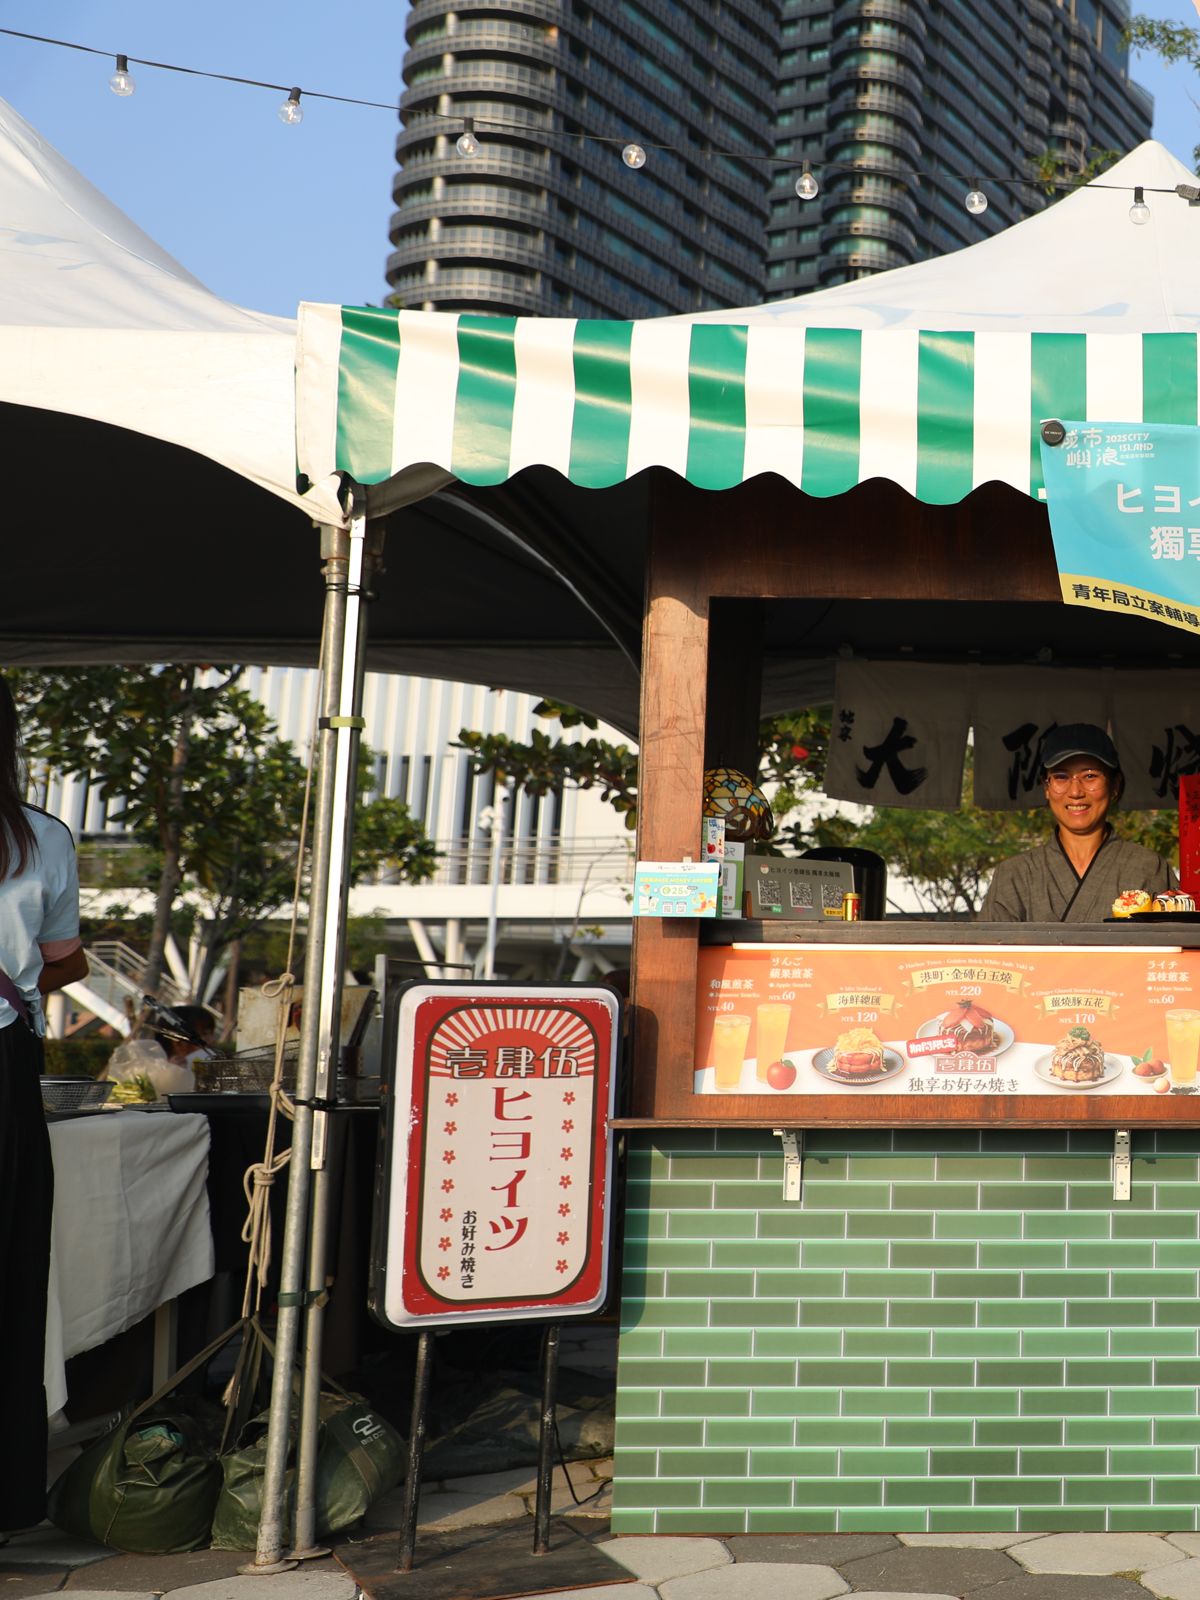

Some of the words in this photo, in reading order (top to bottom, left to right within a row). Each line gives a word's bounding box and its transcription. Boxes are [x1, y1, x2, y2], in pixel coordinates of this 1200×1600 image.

[838, 994, 881, 1006] 海鮮總匯
[908, 1077, 1019, 1092] 独享お好み焼き
[484, 1086, 533, 1252] ヒヨイツ
[460, 1210, 478, 1289] お好み焼き
